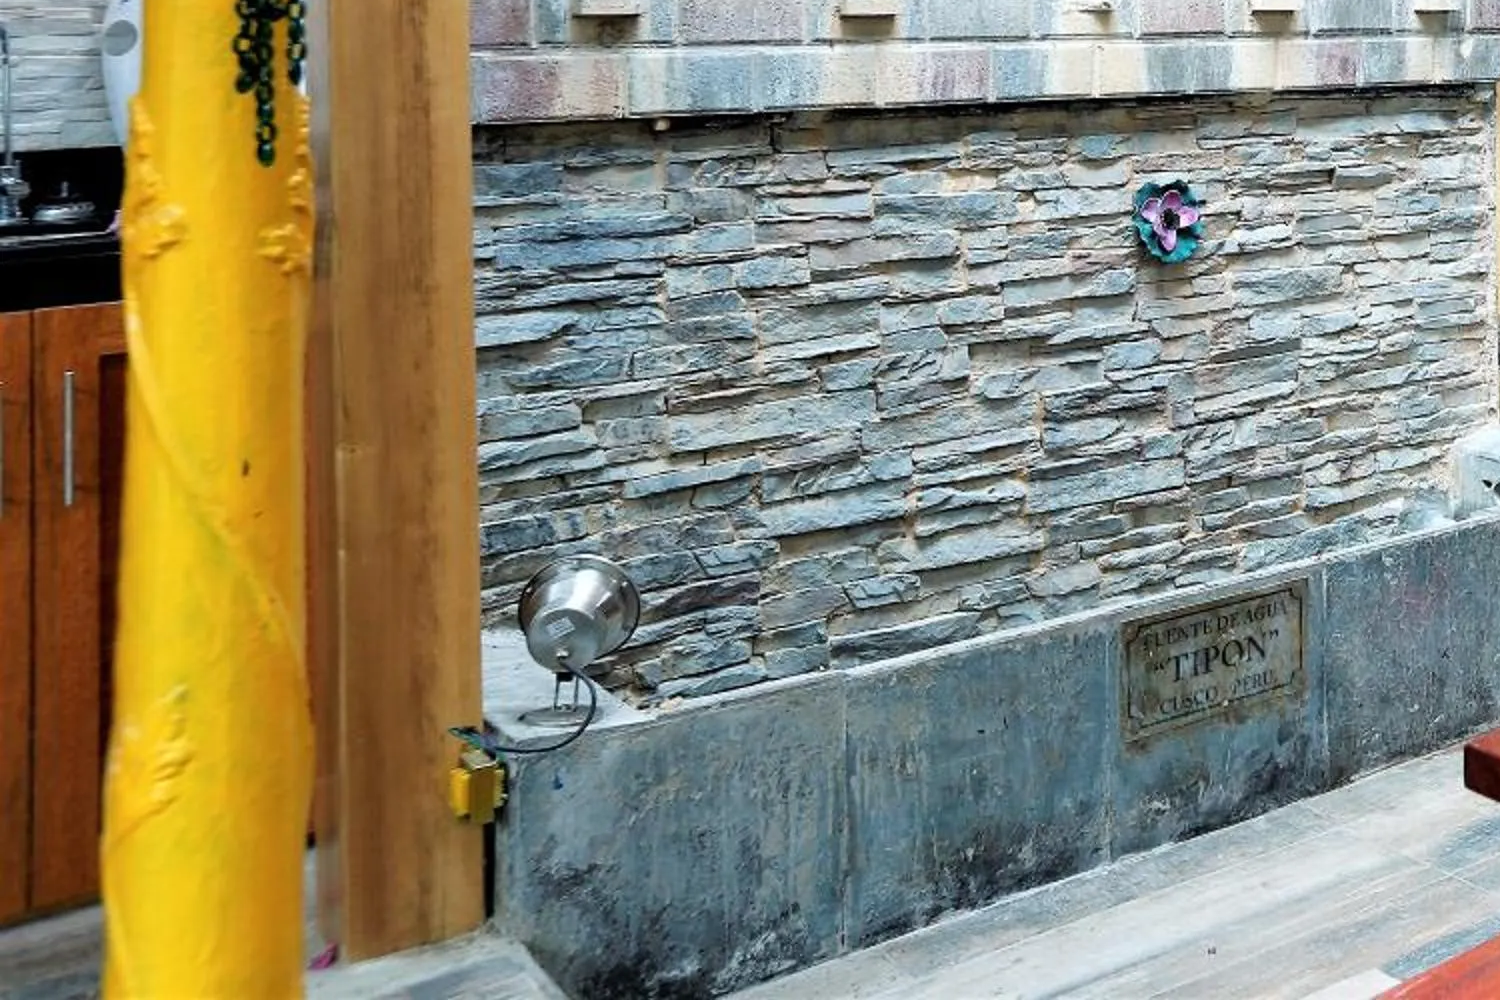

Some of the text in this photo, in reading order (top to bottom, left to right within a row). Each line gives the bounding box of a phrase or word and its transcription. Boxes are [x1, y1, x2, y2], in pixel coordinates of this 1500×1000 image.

[1143, 599, 1288, 649] FUENTE DE AGUA
